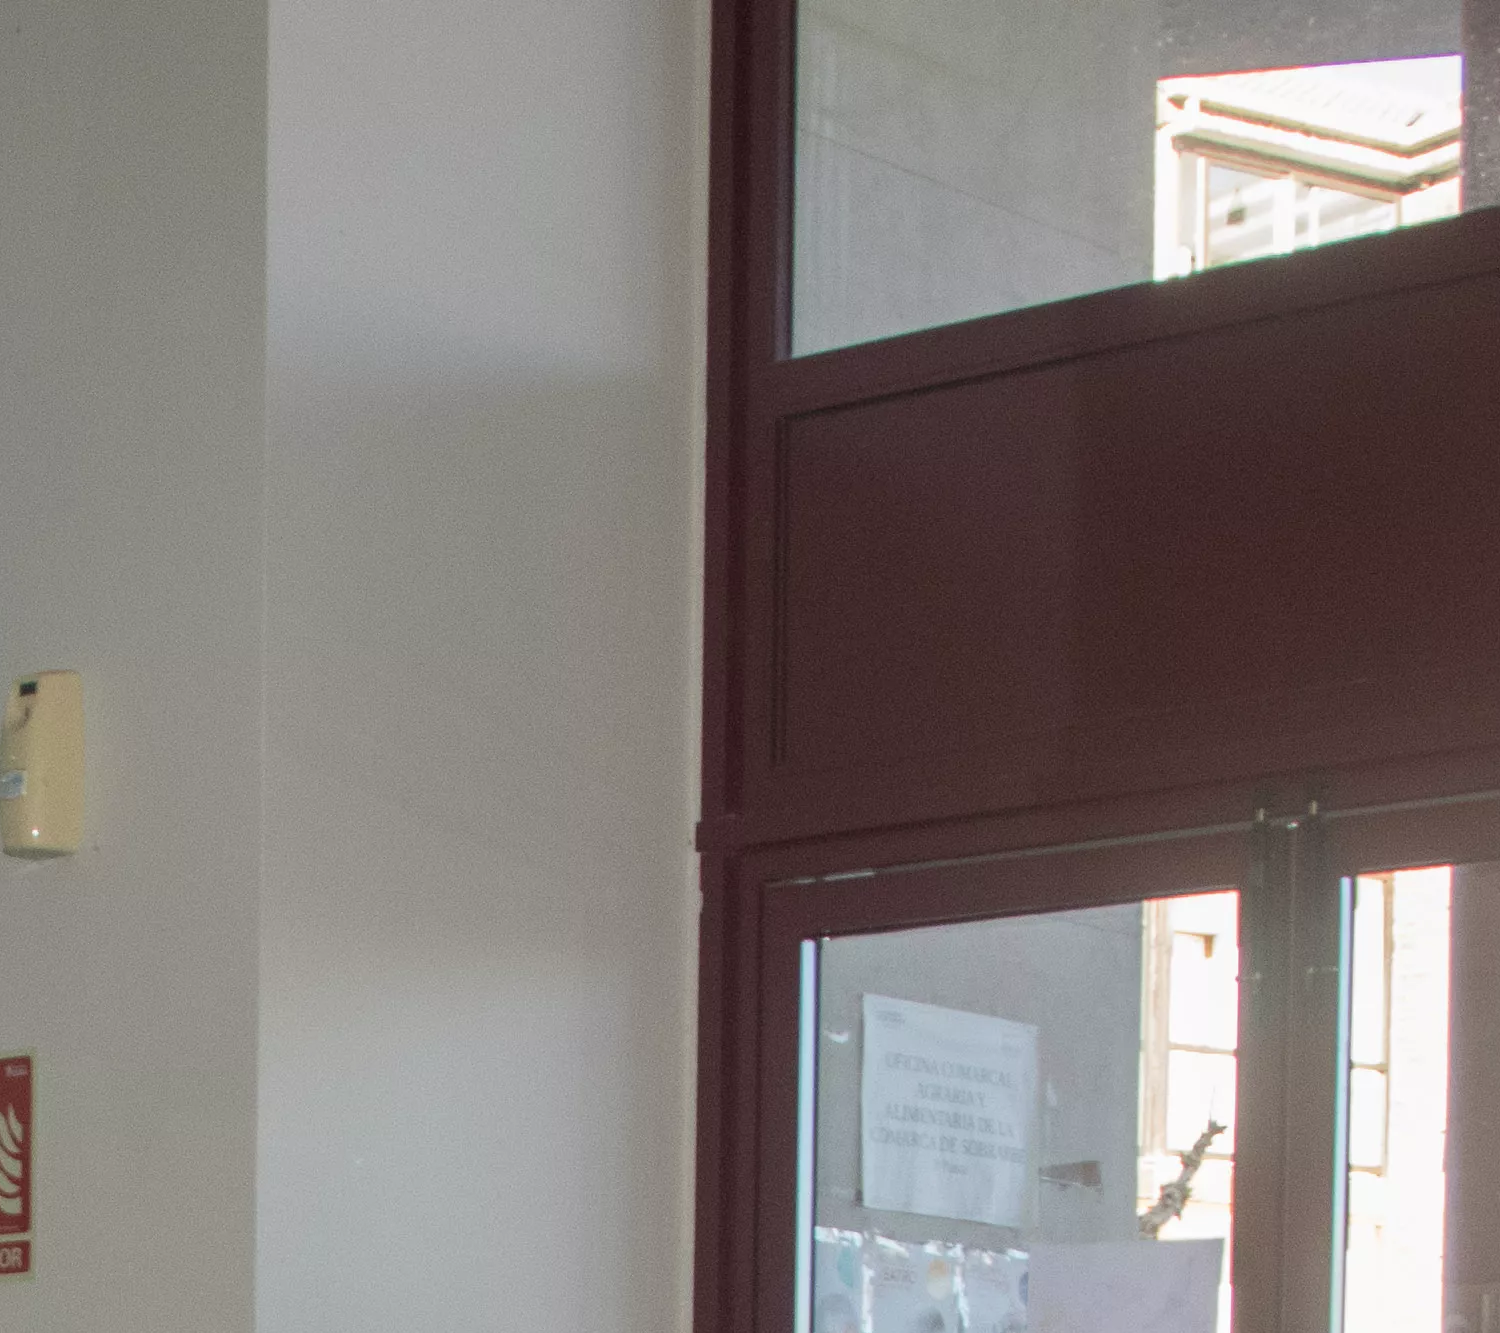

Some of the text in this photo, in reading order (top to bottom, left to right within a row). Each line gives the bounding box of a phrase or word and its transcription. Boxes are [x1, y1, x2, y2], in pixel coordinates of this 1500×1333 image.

[884, 1053, 1014, 1089] OFICINA COMARCAL
[884, 1102, 976, 1131] ALIMENTARIA
